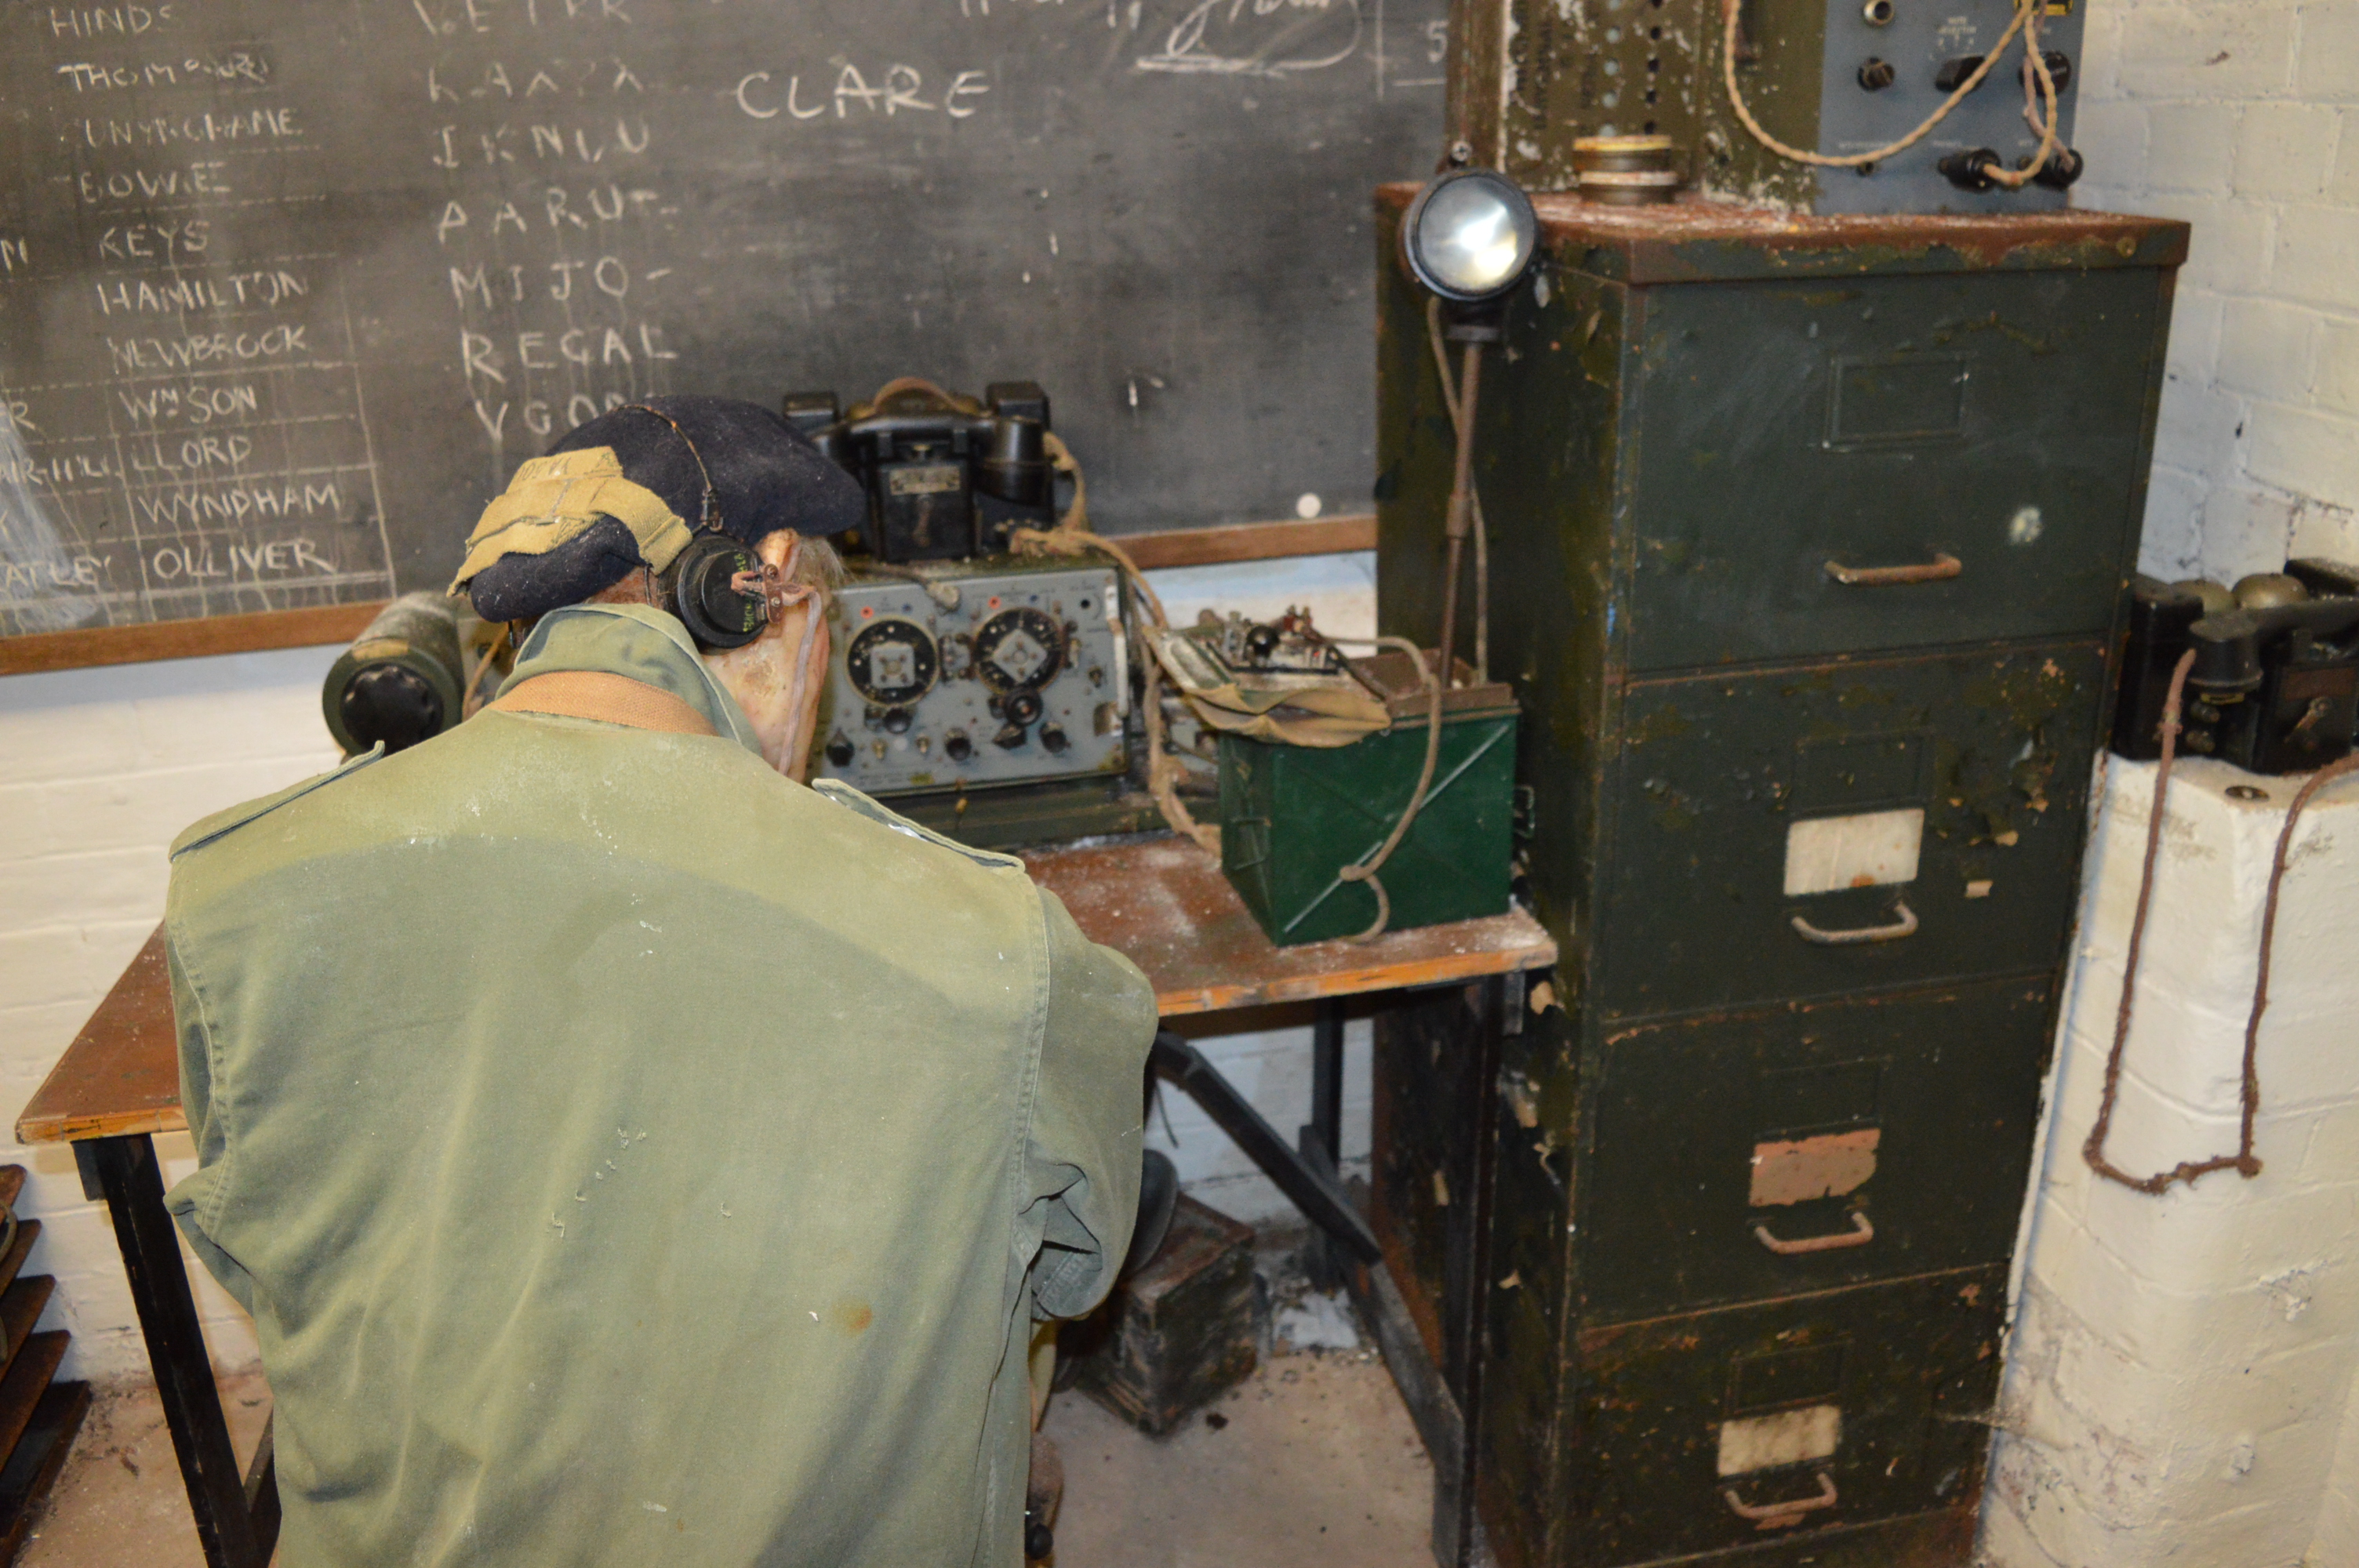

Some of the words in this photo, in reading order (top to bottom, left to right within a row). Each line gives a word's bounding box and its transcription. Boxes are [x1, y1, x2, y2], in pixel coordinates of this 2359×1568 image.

[737, 64, 990, 118] CLARE
[98, 219, 210, 260] KEYS
[97, 270, 310, 316] HAMILTON
[461, 322, 678, 384] REGAL
[138, 483, 341, 524] WYNDHAM
[152, 538, 337, 579] OLLIVER
